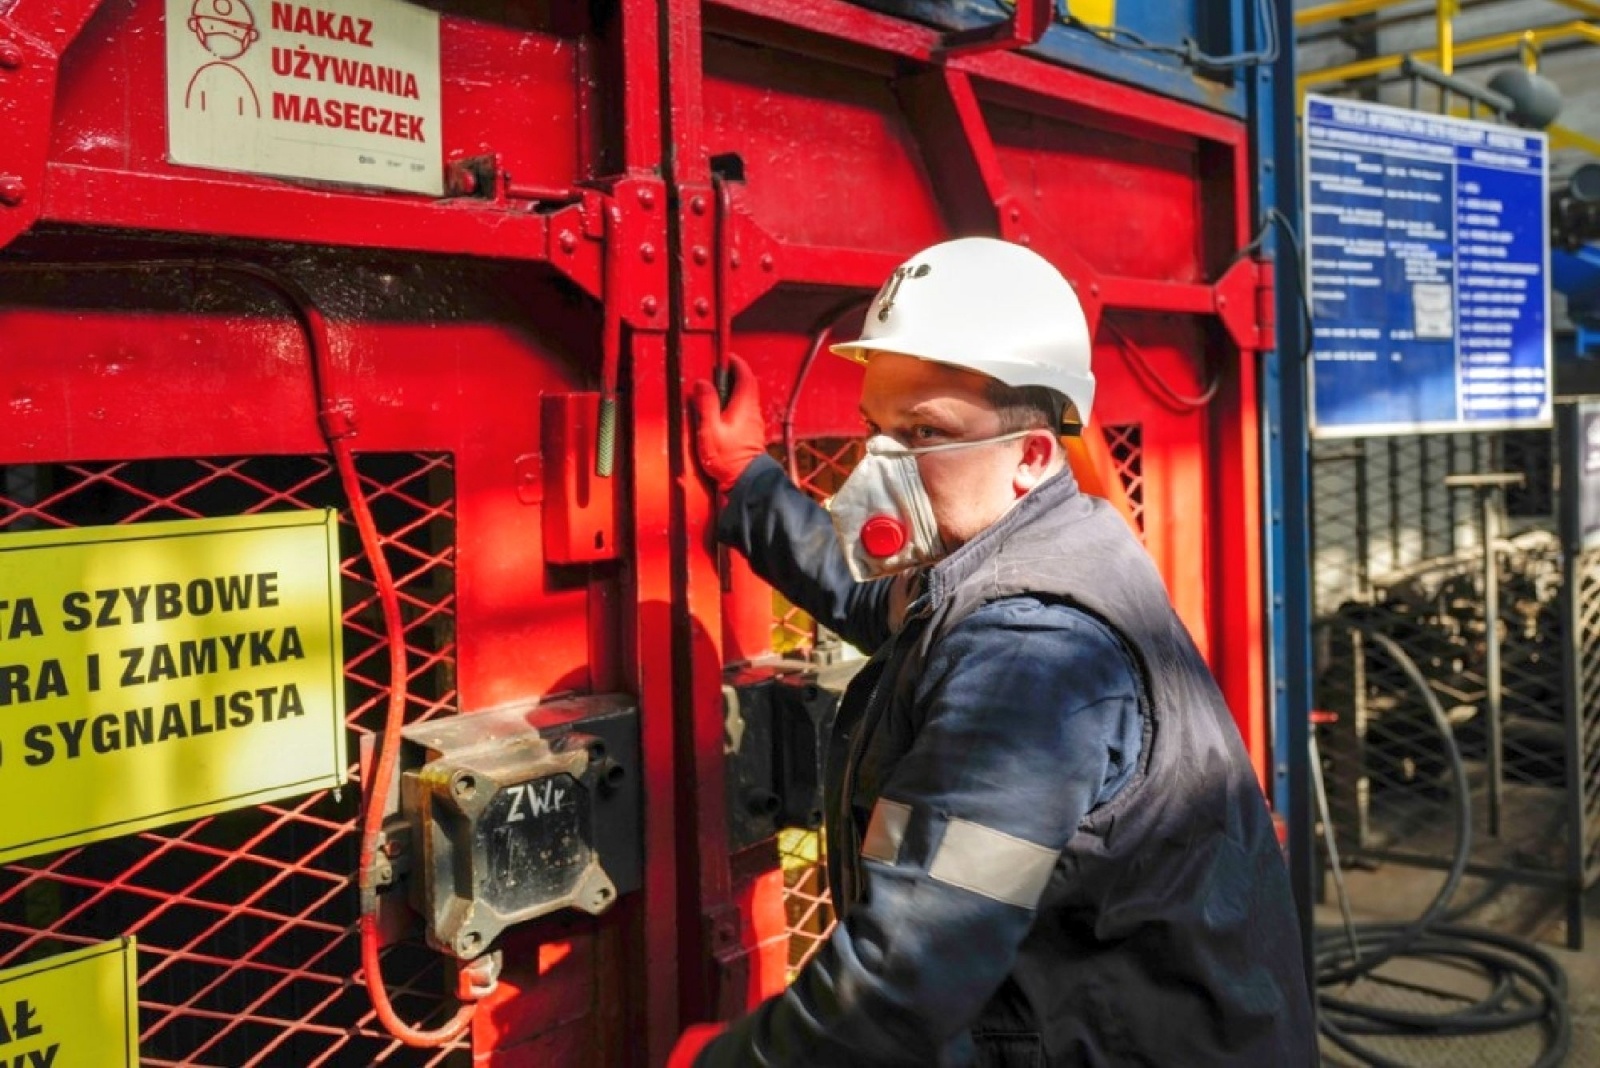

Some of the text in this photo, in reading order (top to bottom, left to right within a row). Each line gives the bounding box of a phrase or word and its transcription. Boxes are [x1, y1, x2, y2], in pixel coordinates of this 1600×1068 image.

[272, 1, 373, 47] NAKAZ
[271, 45, 419, 100] UŻYWANIA
[273, 93, 425, 142] MASECZEK
[63, 572, 279, 632] SZYBOWE
[0, 626, 305, 706] RA I ZAMYKA
[24, 683, 305, 766] SYGNALISTA
